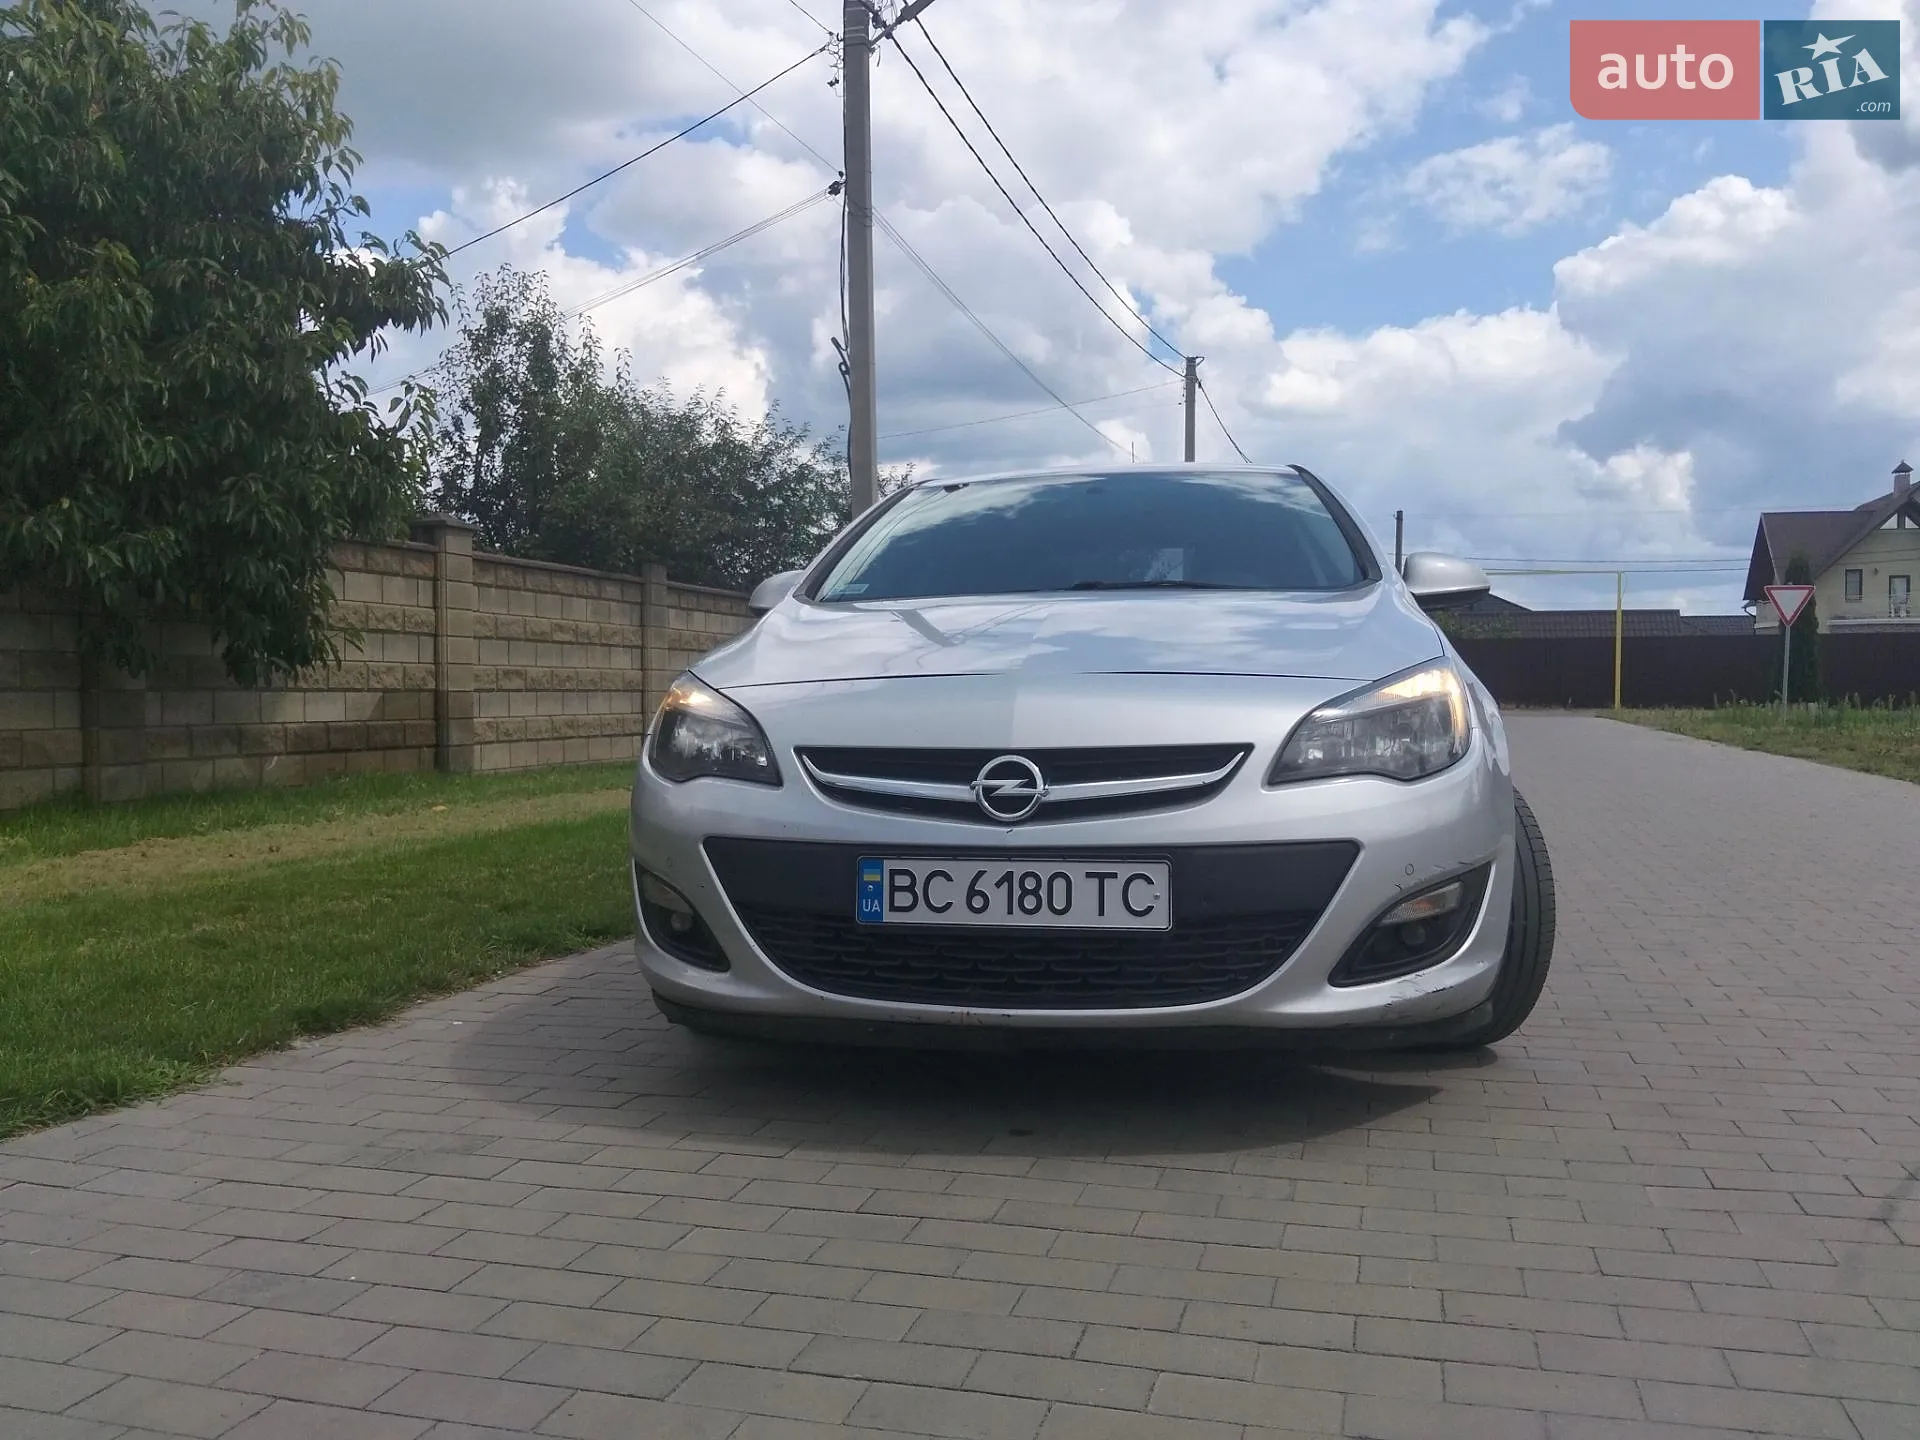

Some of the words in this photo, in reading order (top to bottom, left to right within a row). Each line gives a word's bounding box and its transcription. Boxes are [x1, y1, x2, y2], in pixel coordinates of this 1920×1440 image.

[862, 899, 881, 913] UA
[888, 868, 954, 914] BC
[965, 870, 1073, 916] 6180
[1085, 871, 1155, 917] TC
